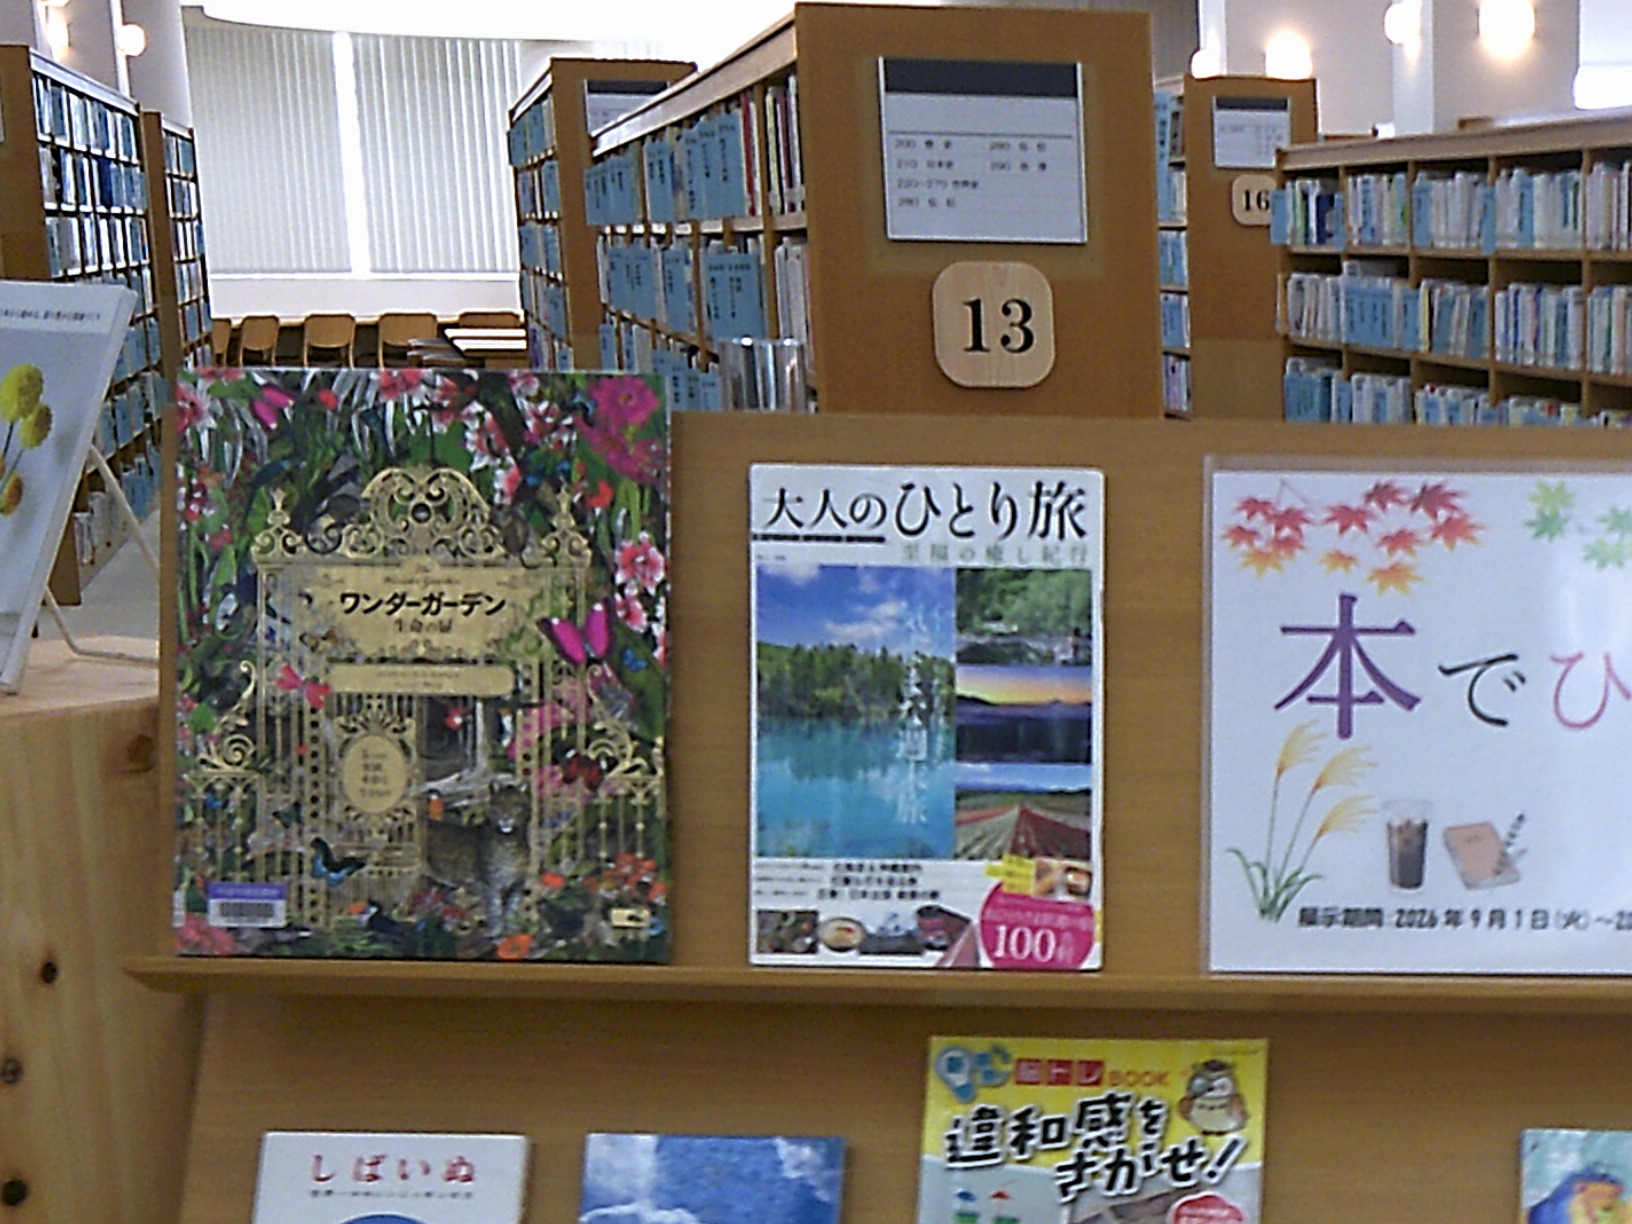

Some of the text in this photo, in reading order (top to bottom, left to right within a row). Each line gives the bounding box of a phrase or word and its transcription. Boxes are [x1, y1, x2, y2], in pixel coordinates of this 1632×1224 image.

[1242, 189, 1270, 211] 16
[963, 297, 1034, 353] 13
[764, 480, 1087, 542] 大人のひとり旅
[340, 592, 506, 616] ワンダーガーデン
[1108, 1069, 1170, 1087] BOOK
[946, 1092, 1166, 1163] 違和感を
[311, 1154, 476, 1183] しばいぬ
